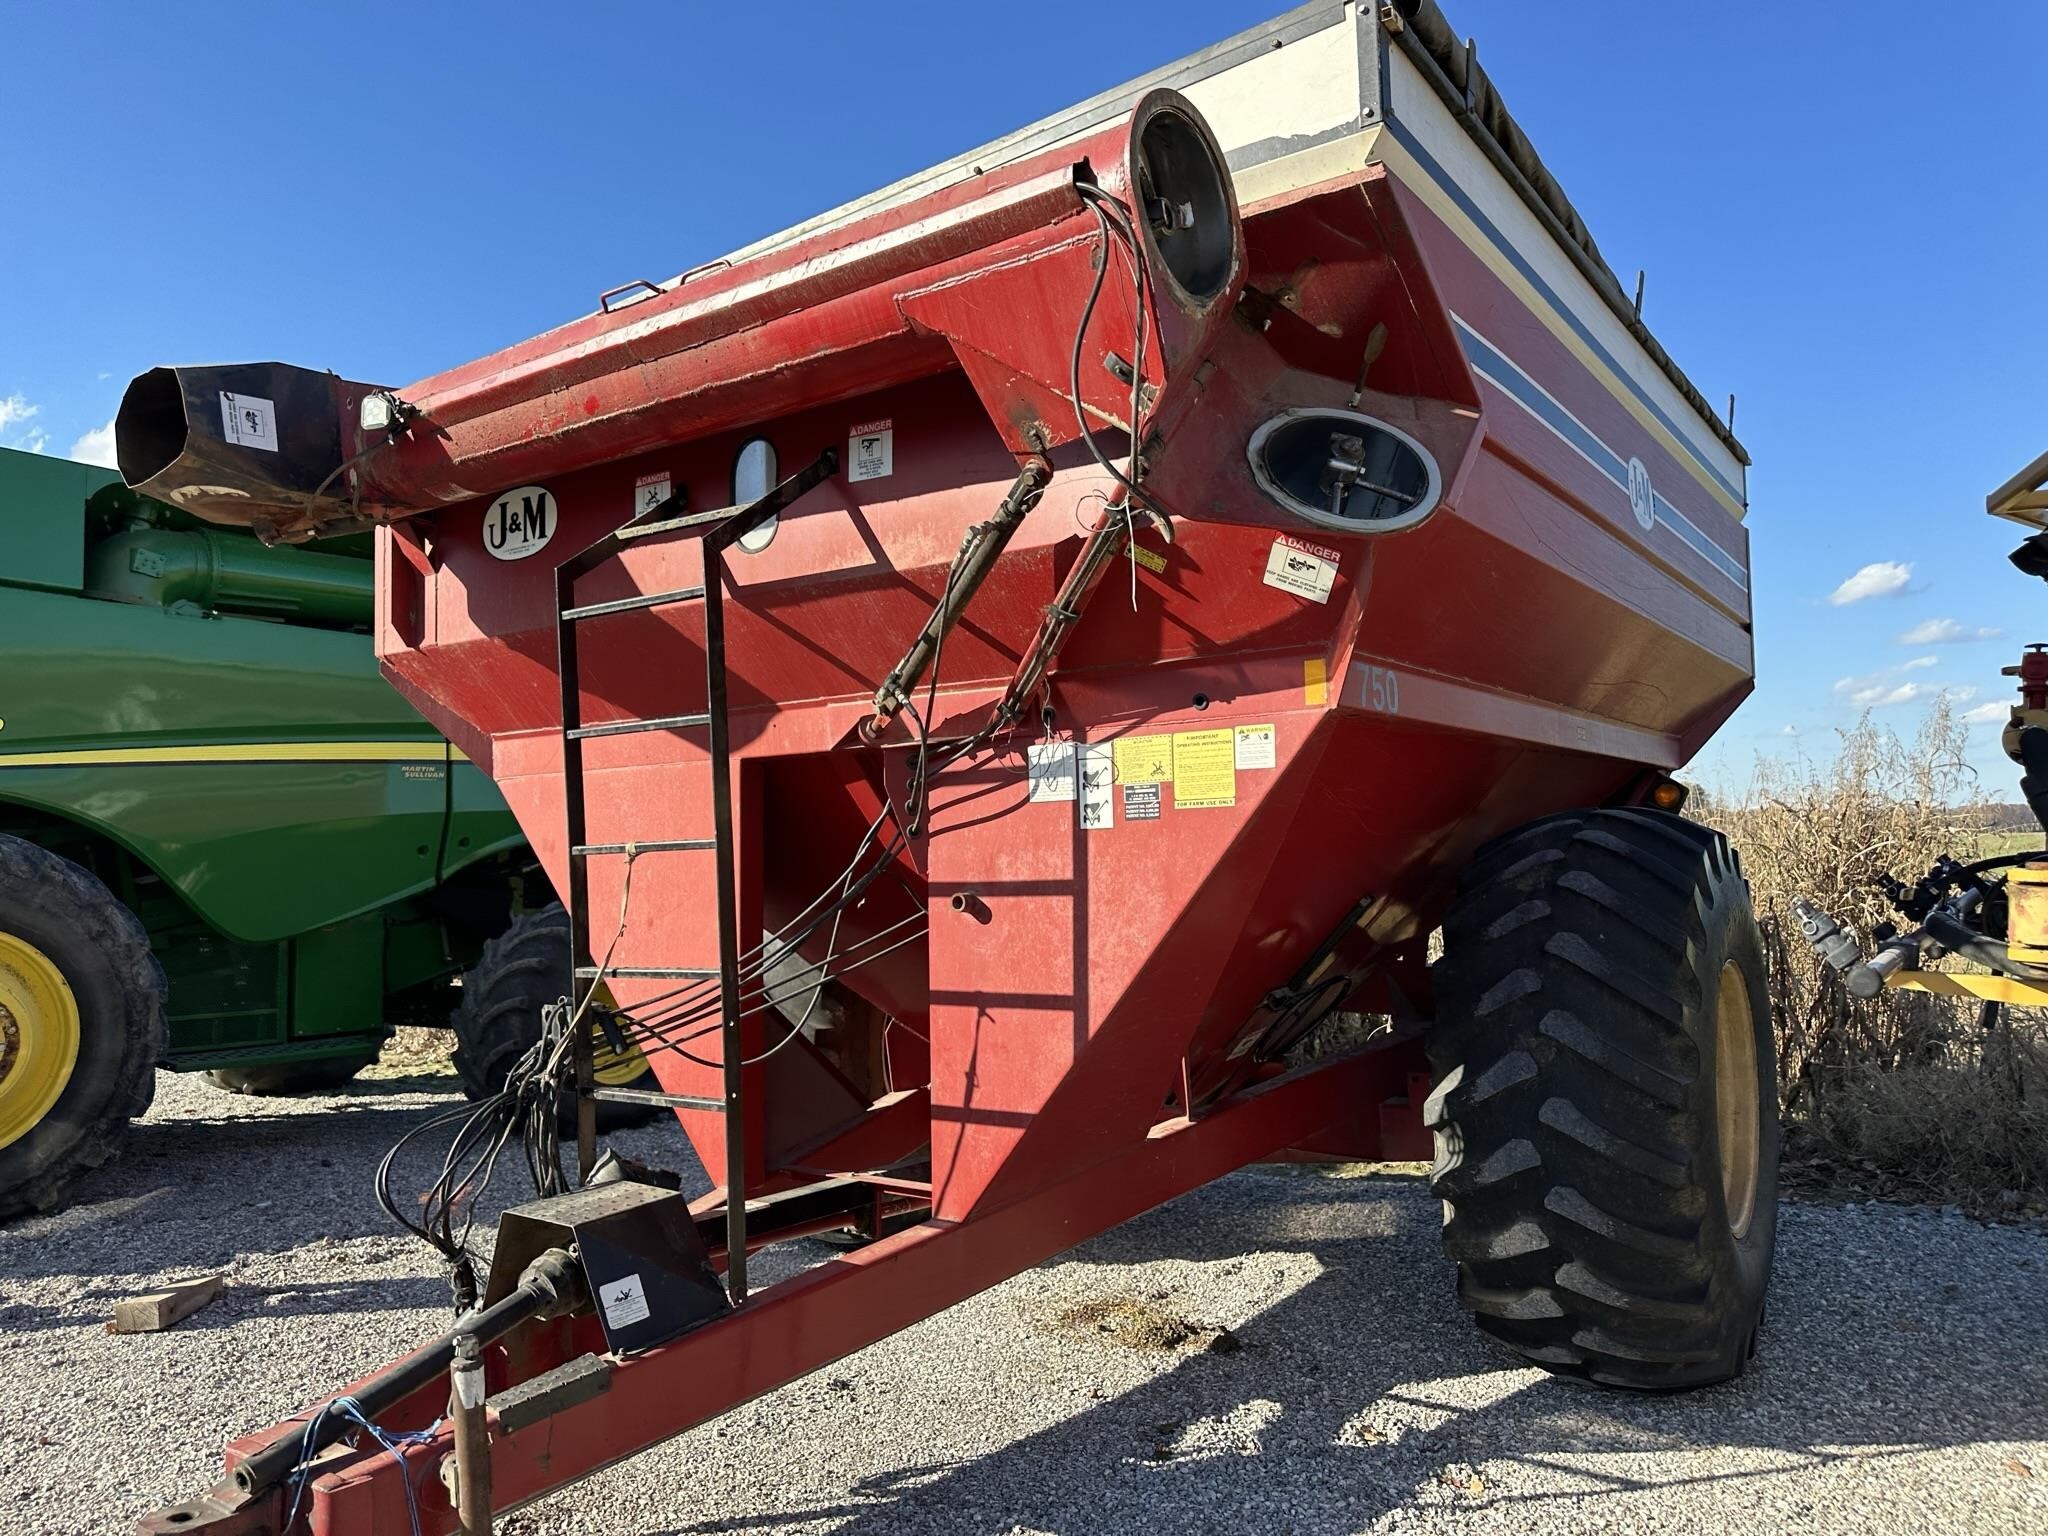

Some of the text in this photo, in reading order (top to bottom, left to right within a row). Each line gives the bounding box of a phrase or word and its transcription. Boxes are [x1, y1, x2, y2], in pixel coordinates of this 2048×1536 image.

[857, 420, 892, 435] DANGER
[642, 471, 670, 485] DANGER
[1630, 464, 1652, 520] J&M
[488, 492, 548, 549] J&M
[1288, 537, 1341, 562] DANGER
[1355, 661, 1399, 713] 750
